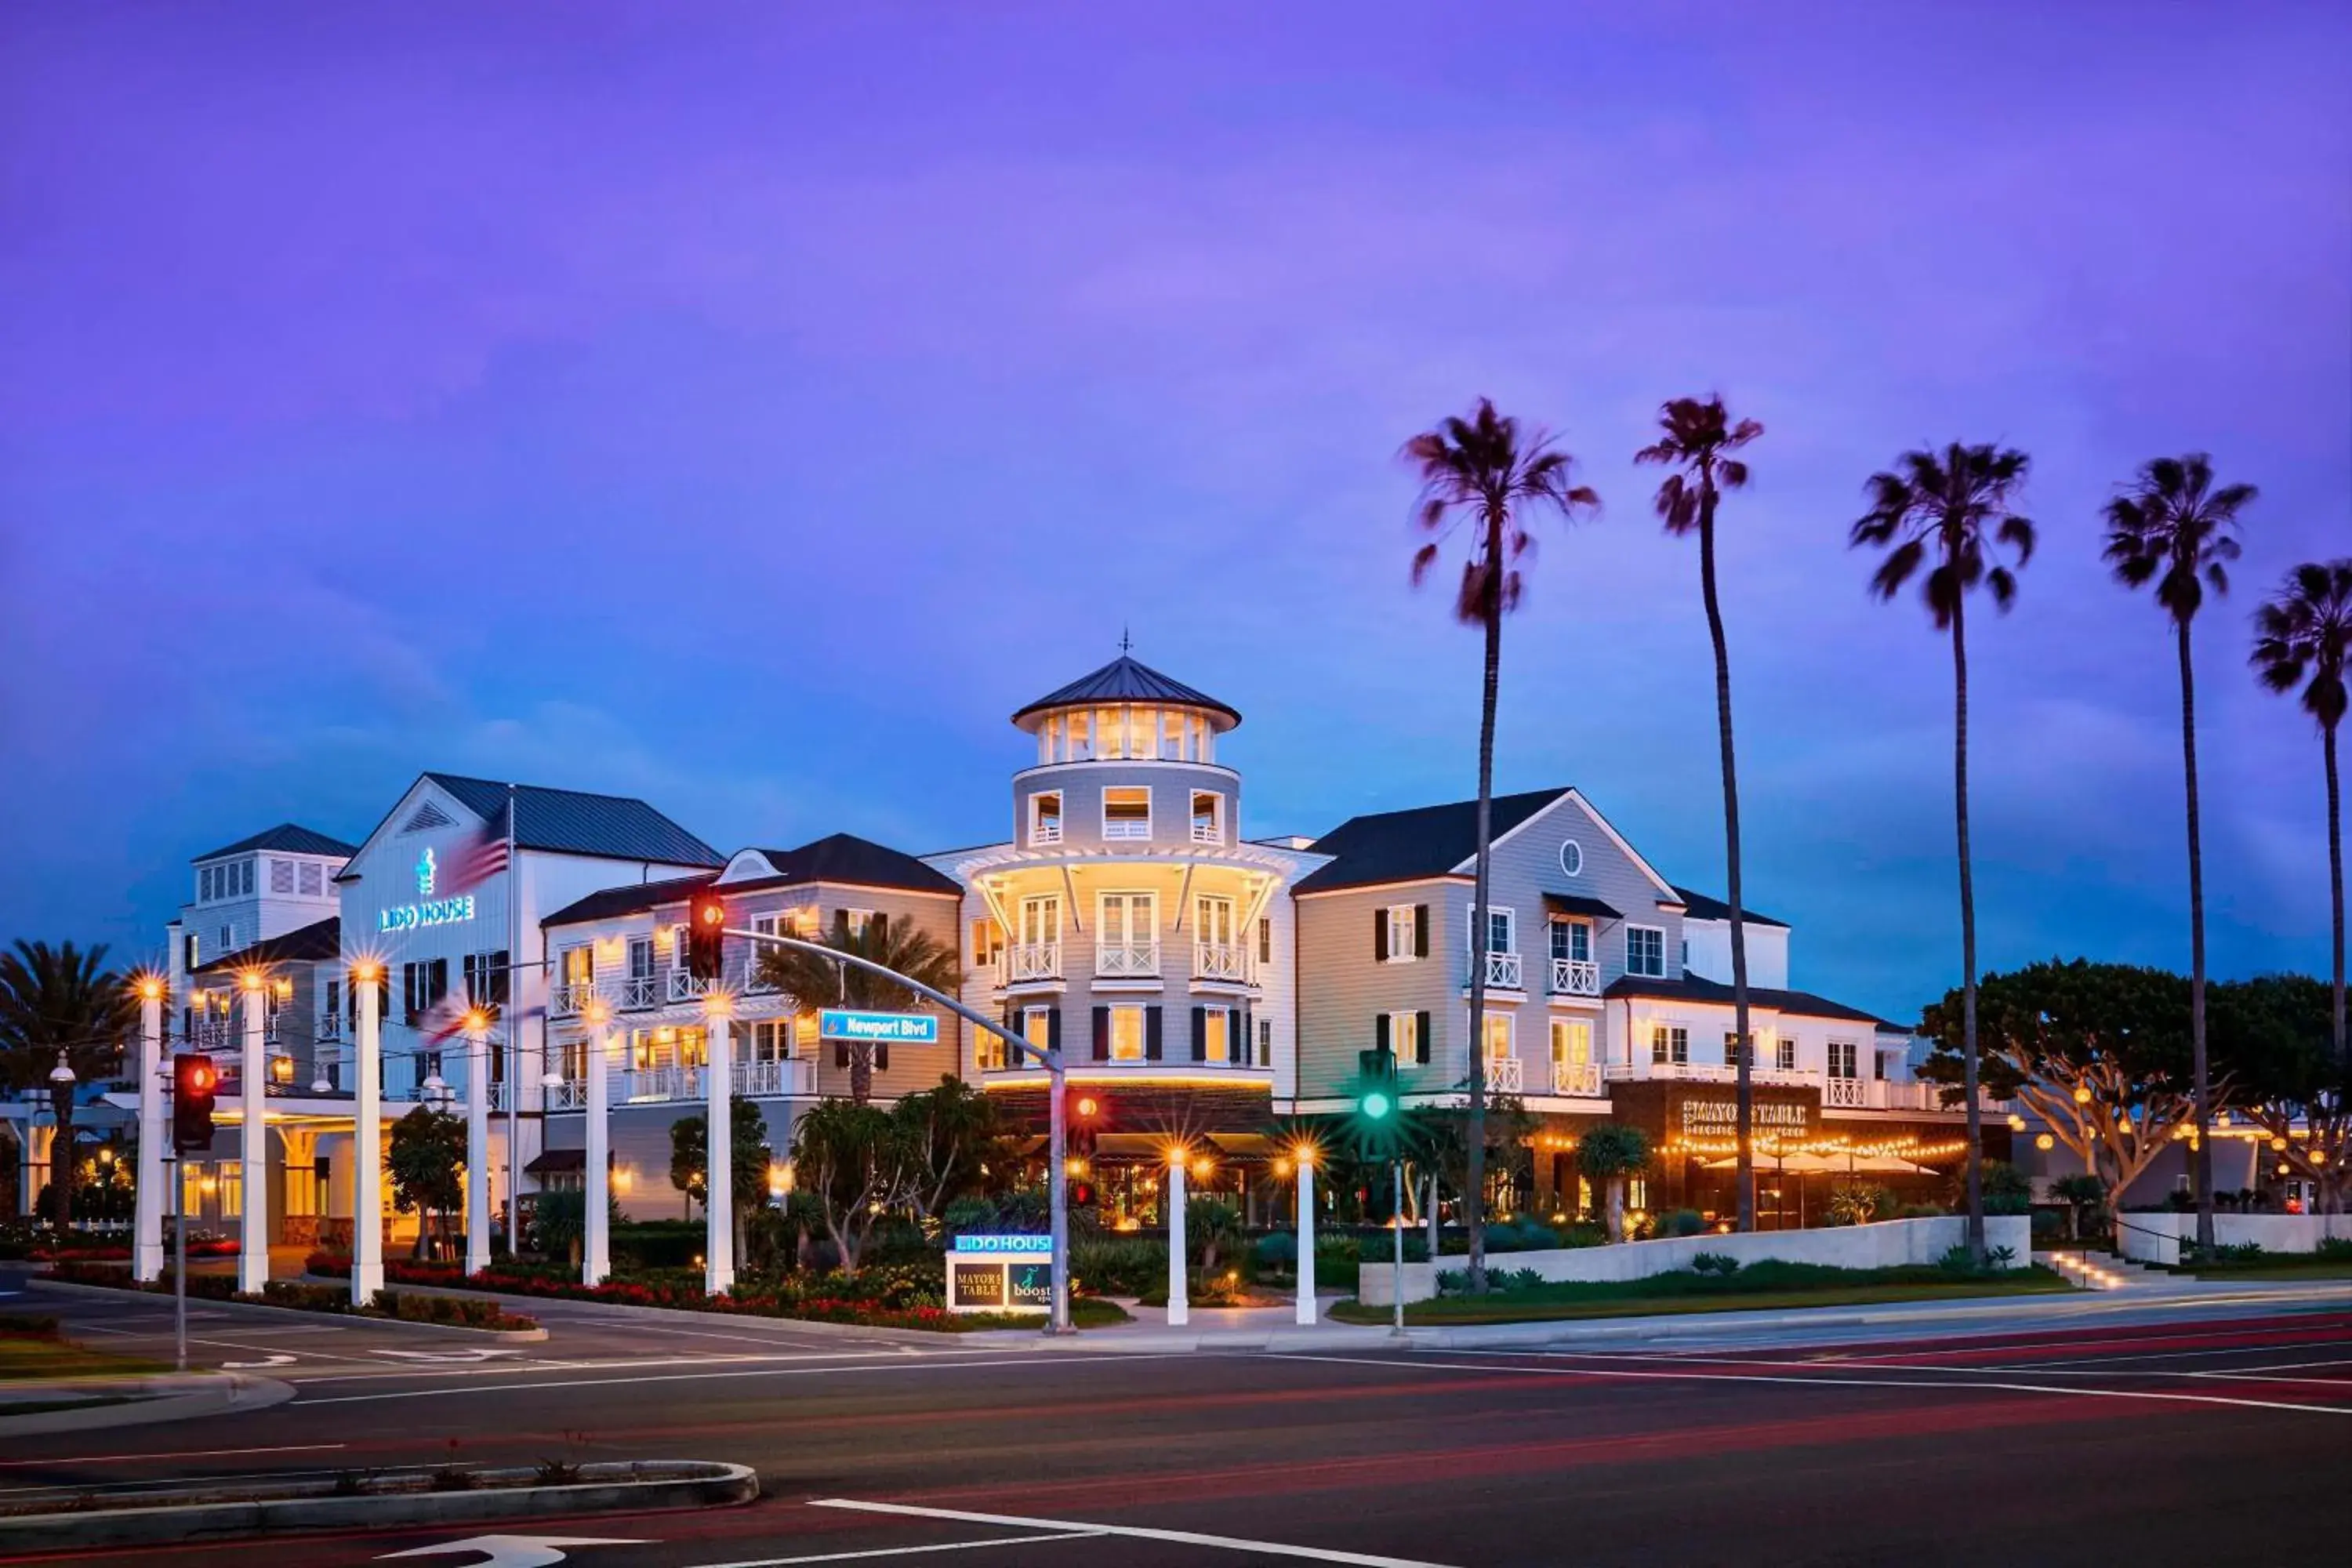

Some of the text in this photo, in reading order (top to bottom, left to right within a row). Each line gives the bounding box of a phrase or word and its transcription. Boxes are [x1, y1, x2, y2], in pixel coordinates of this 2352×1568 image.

[379, 895, 474, 933] LIDO HOUSE
[847, 1016, 928, 1038] Newport Blvd
[956, 1236, 998, 1250] LIDO
[961, 1285, 998, 1296] TABLE
[1014, 1283, 1051, 1296] boost
